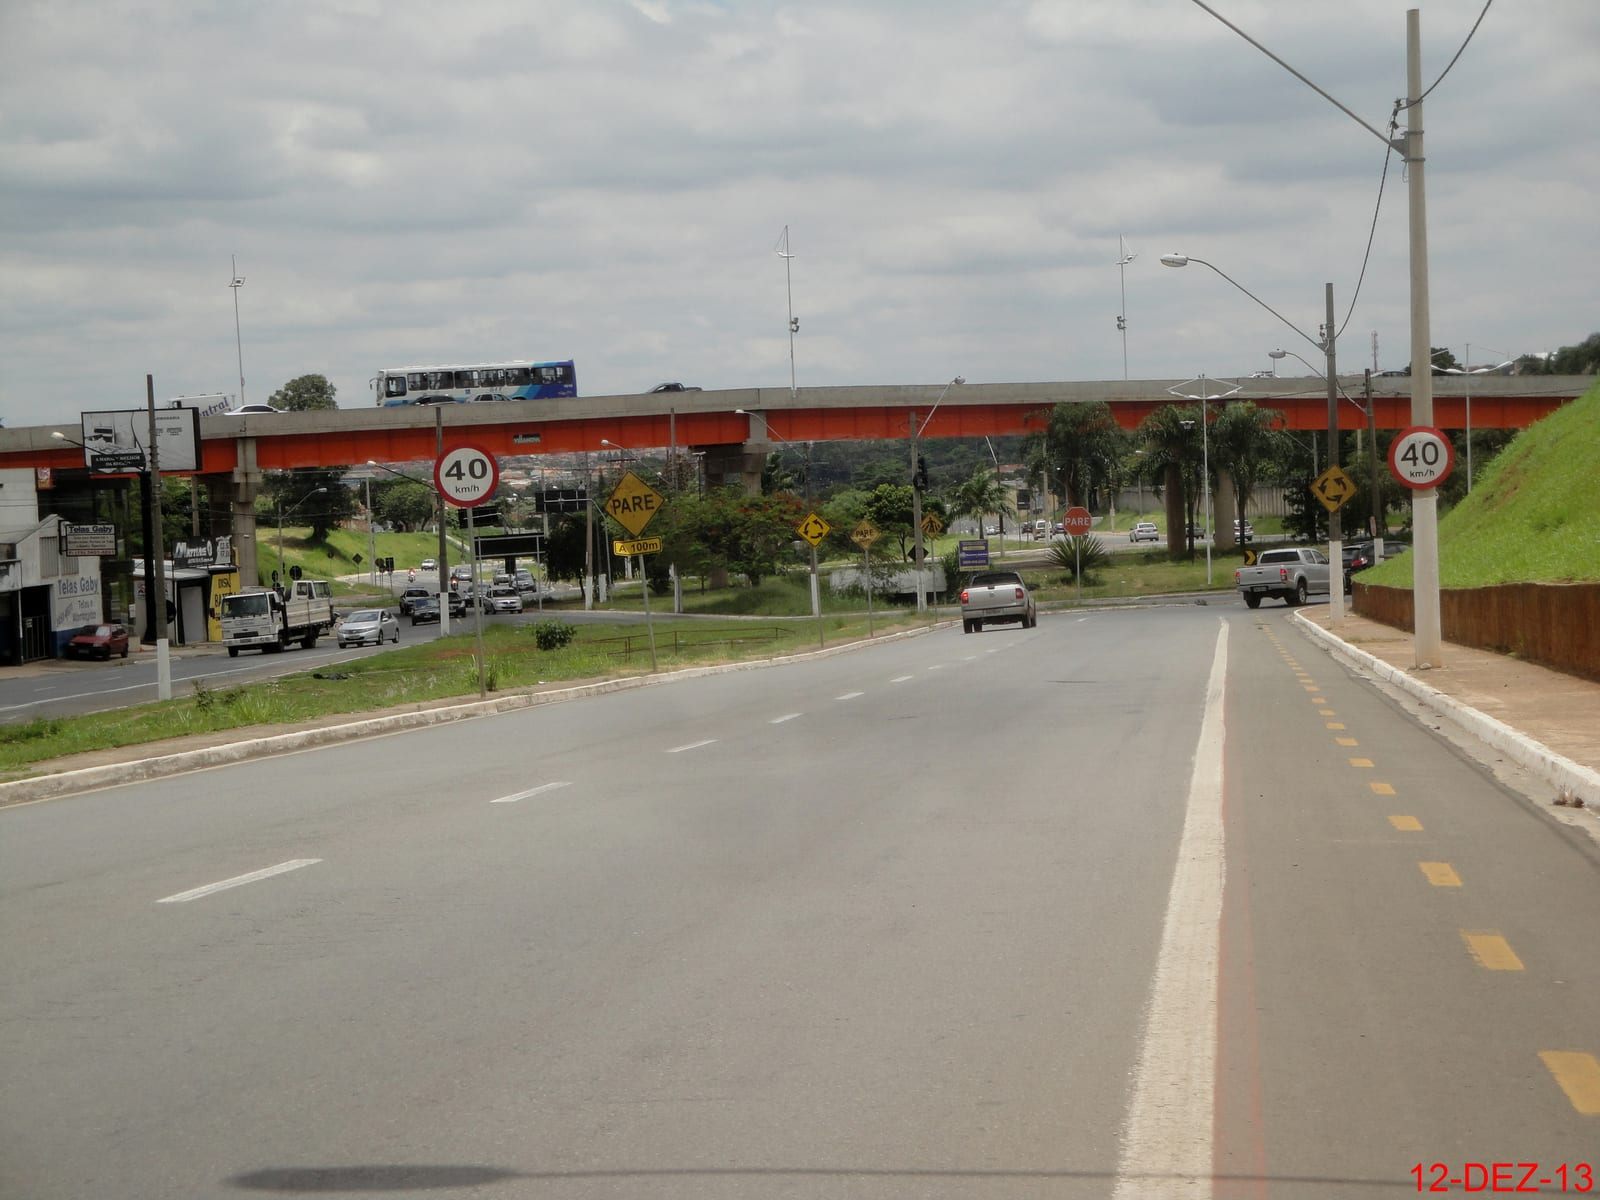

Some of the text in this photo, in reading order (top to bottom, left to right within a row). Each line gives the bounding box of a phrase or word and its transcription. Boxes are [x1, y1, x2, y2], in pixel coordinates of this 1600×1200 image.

[199, 396, 229, 416] ntral
[1401, 441, 1439, 467] 40
[445, 458, 488, 481] 40
[1409, 468, 1435, 478] km/h
[455, 484, 480, 493] km/h
[612, 494, 655, 515] PARE
[1065, 517, 1090, 526] PARE
[92, 525, 112, 534] Gaby
[855, 529, 874, 538] PARE
[619, 542, 658, 553] A 100m
[58, 576, 99, 595] Telas Gaby
